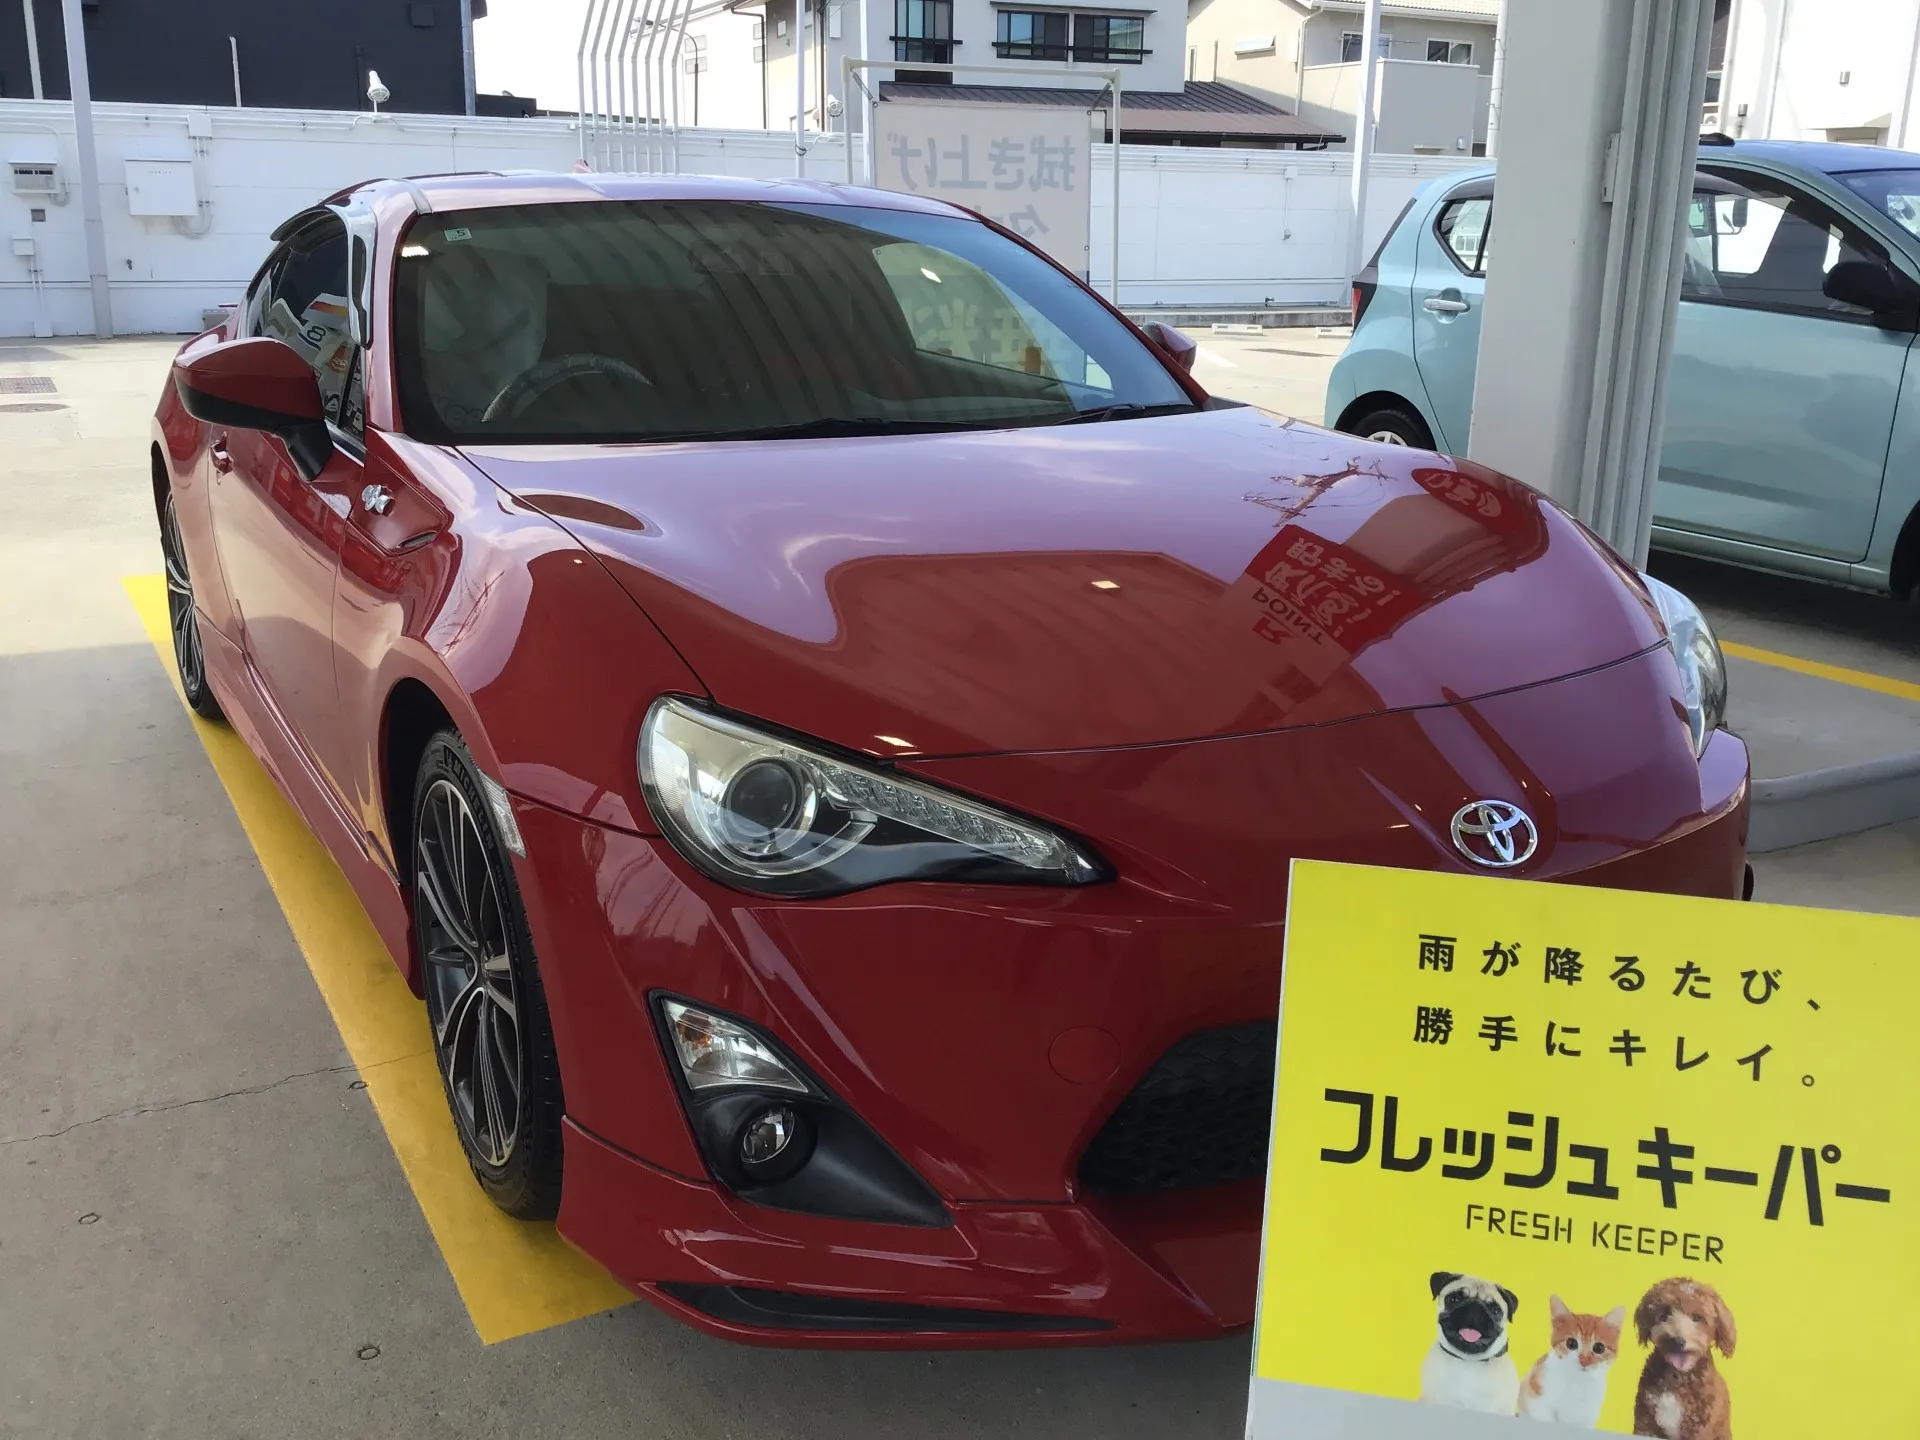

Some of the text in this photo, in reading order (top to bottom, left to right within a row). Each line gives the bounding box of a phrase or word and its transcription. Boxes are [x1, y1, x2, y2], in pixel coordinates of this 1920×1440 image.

[452, 760, 496, 851] MICHELIN
[1417, 933, 1819, 1011] 雨が降るたび、
[1413, 1005, 1816, 1087] 勝手にキレイ。
[1320, 1088, 1891, 1227] フレッシュキーパー
[1465, 1203, 1725, 1264] FRESH KEEPER
